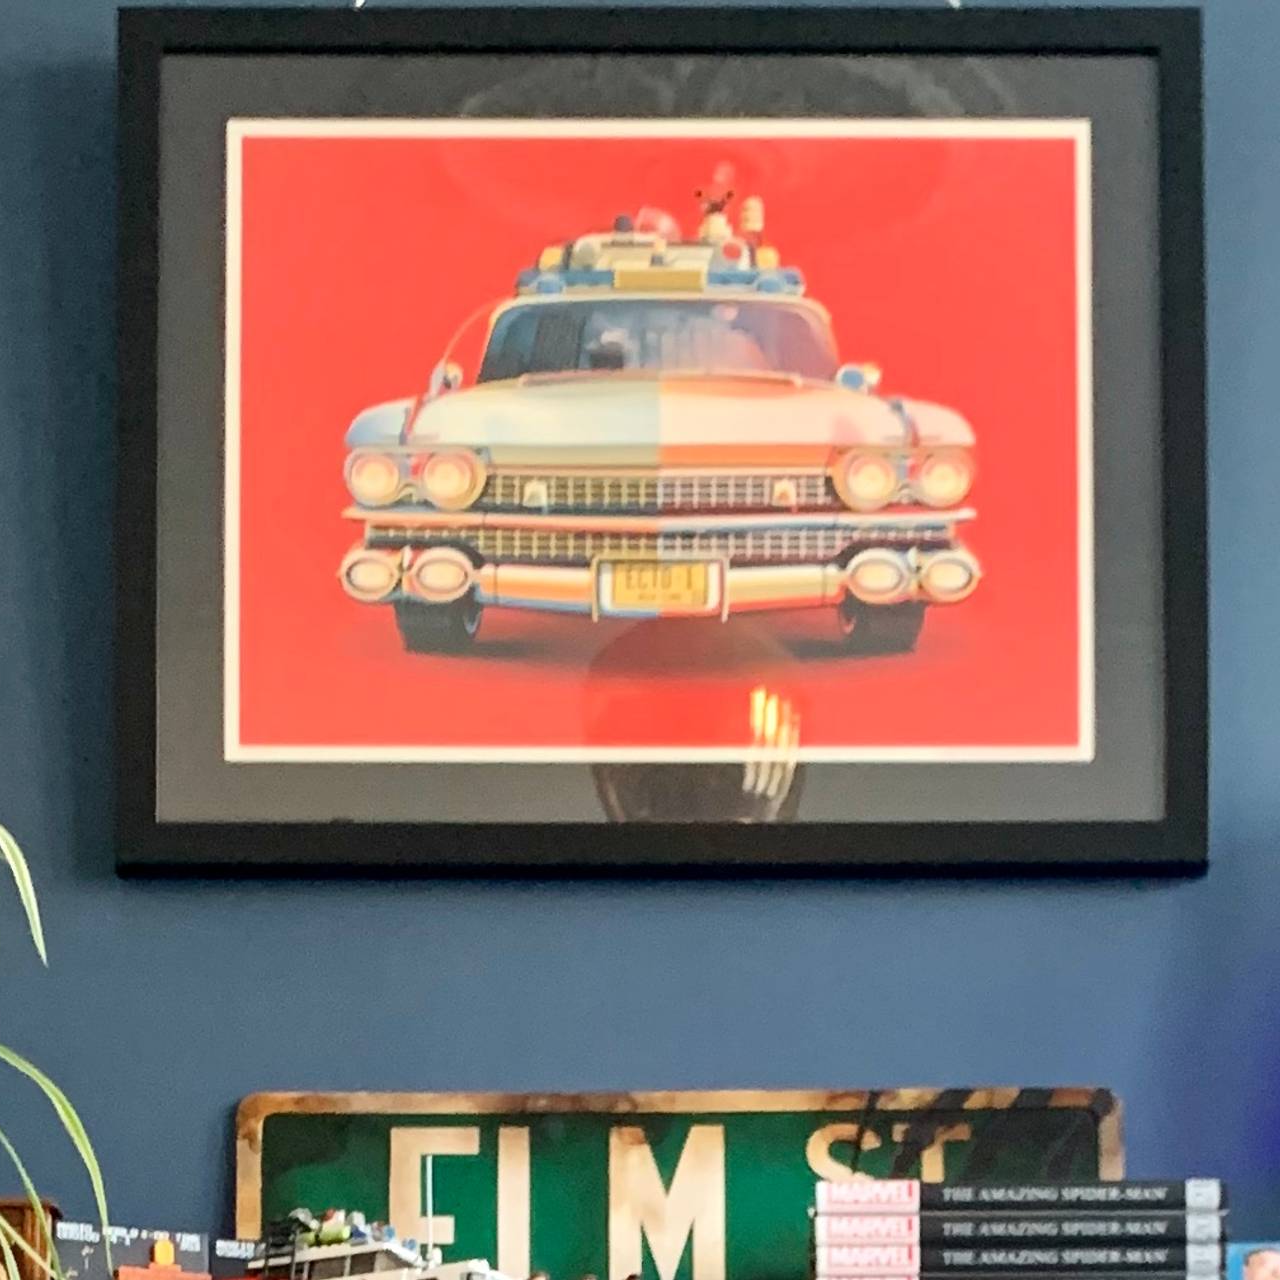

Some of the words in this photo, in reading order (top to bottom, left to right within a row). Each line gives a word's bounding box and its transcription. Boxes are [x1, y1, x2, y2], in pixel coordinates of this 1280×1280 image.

[828, 1183, 915, 1203] MARVEL
[942, 1186, 974, 1202] THE
[979, 1186, 1059, 1202] AMAZING
[1062, 1186, 1169, 1202] SPIDER-MAN
[828, 1218, 915, 1236] MARVEL
[942, 1222, 974, 1237] THE
[979, 1222, 1059, 1237] AMAZING
[1062, 1222, 1169, 1237] SPIDER-MAN
[828, 1247, 915, 1265] MARVEL
[942, 1249, 974, 1266] THE
[979, 1249, 1059, 1266] AMAZING
[1062, 1249, 1169, 1266] SPIDER-MAN
